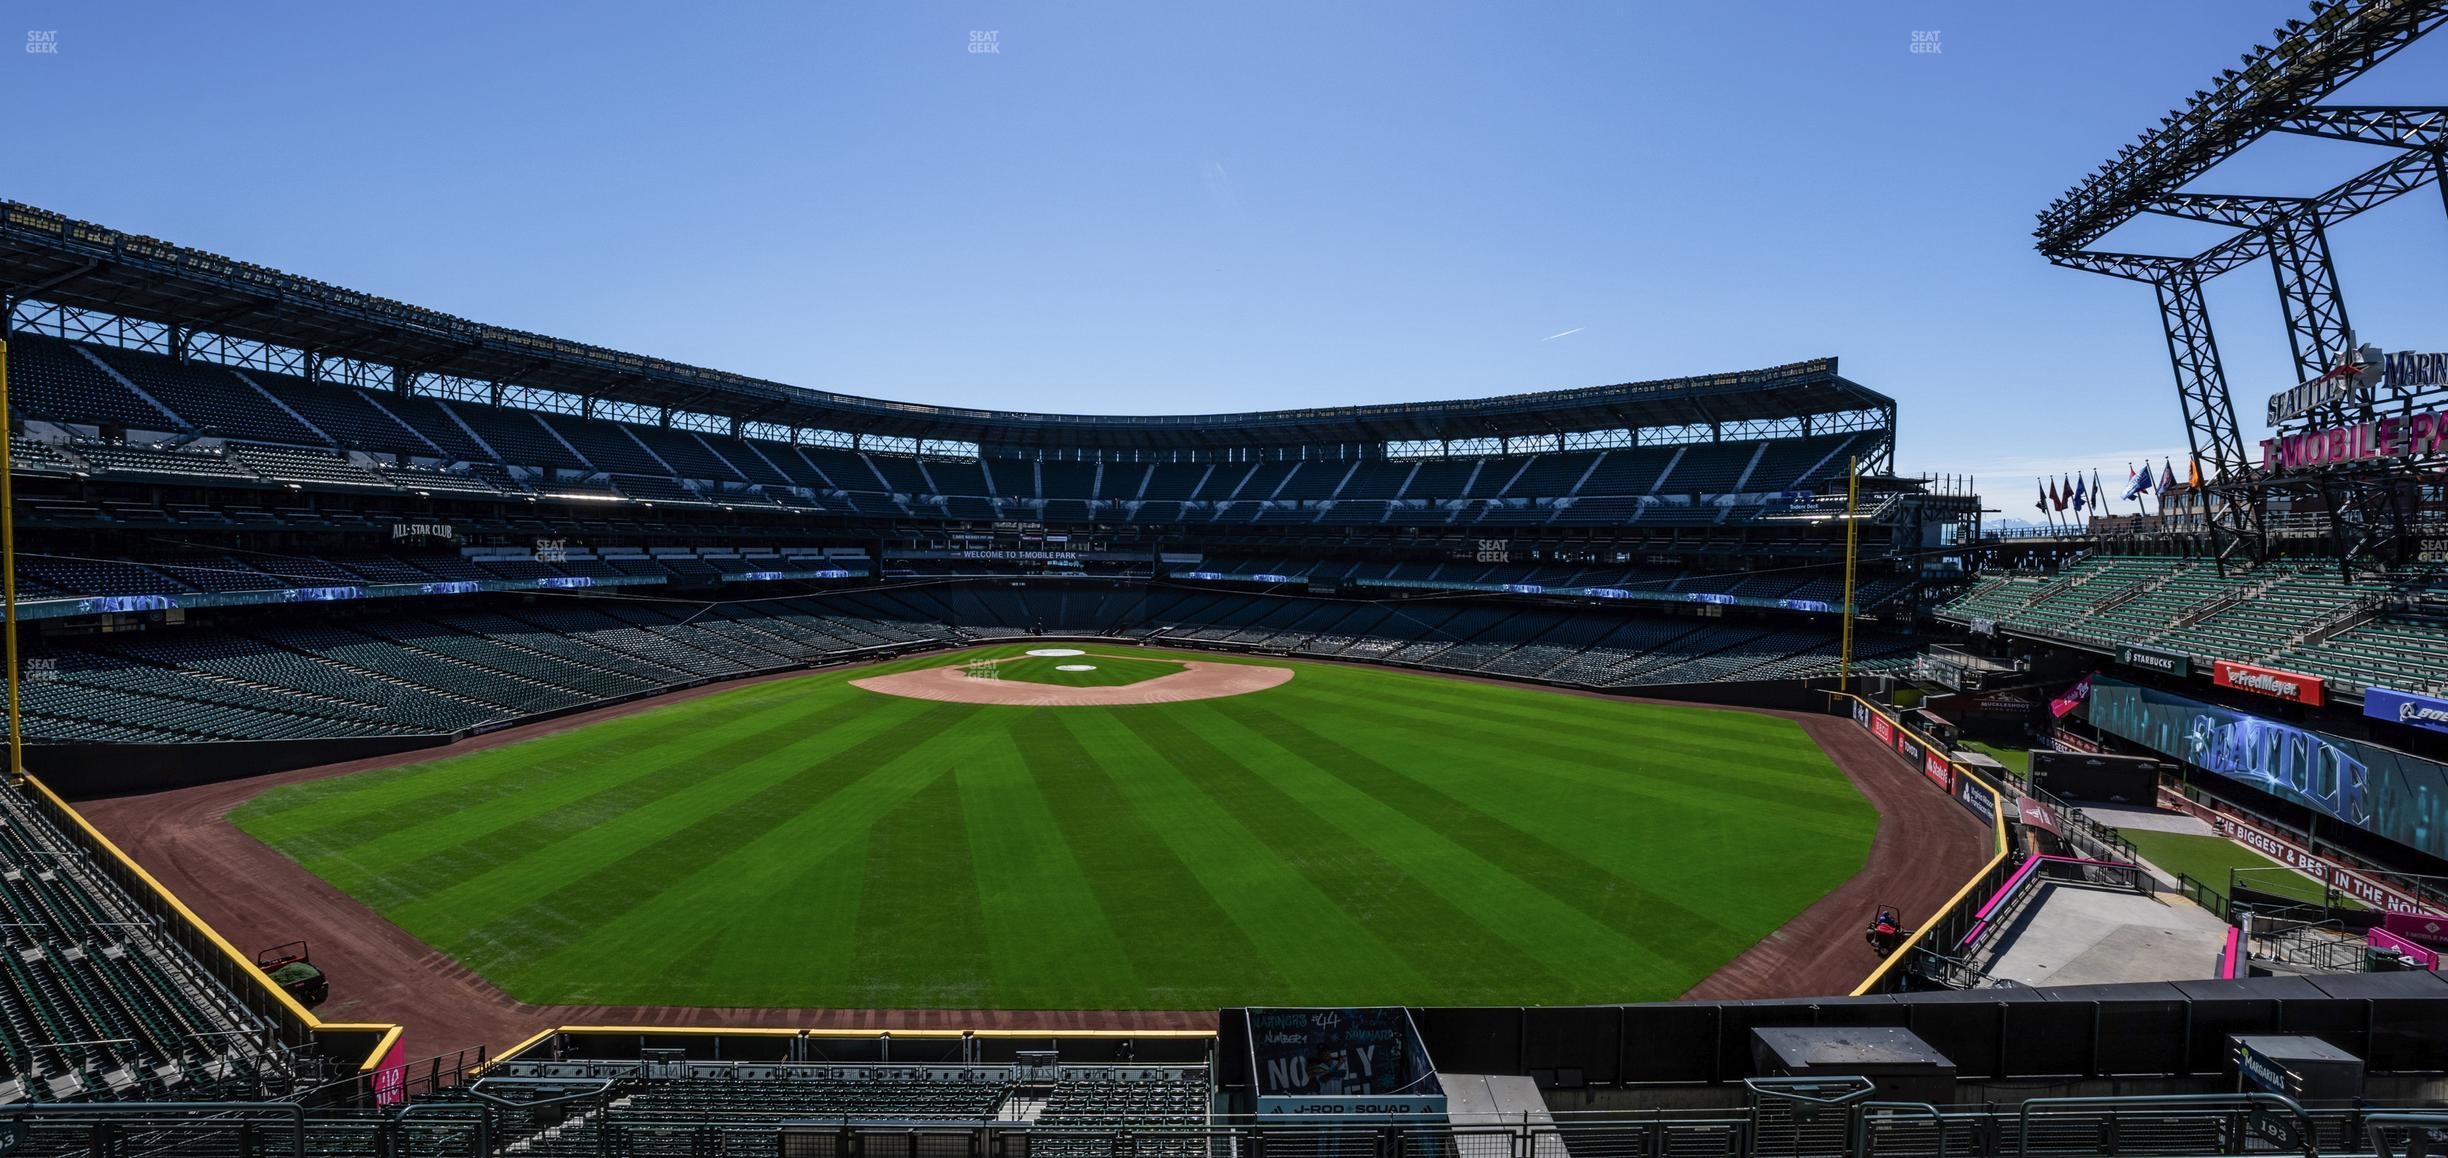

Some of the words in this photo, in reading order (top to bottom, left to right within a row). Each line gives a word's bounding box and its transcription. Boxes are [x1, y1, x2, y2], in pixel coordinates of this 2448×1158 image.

[2267, 377, 2338, 427] SEATTLE
[2260, 417, 2403, 473] T-MOBILE
[432, 524, 452, 539] CLUB
[963, 550, 1004, 559] WELCOME
[1006, 550, 1017, 559] TO
[1019, 550, 1054, 560] T-MOBILE
[1055, 551, 1077, 560] PARK
[2133, 652, 2172, 669] STARBUCKS
[1981, 701, 2030, 709] MUCKLESHOOT
[1904, 741, 1919, 760] TOYOTA
[2236, 826, 2285, 857] BIGGEST
[2286, 849, 2296, 864] &
[2335, 869, 2350, 890] IN
[2353, 879, 2383, 906] THE
[1311, 1010, 1341, 1030] #44
[1267, 1055, 1310, 1091] NO
[2244, 1055, 2285, 1090] MARGARITAS
[1294, 1104, 1345, 1114] J-ROD
[1355, 1104, 1410, 1115] SQUAD
[2260, 1119, 2287, 1142] 193
